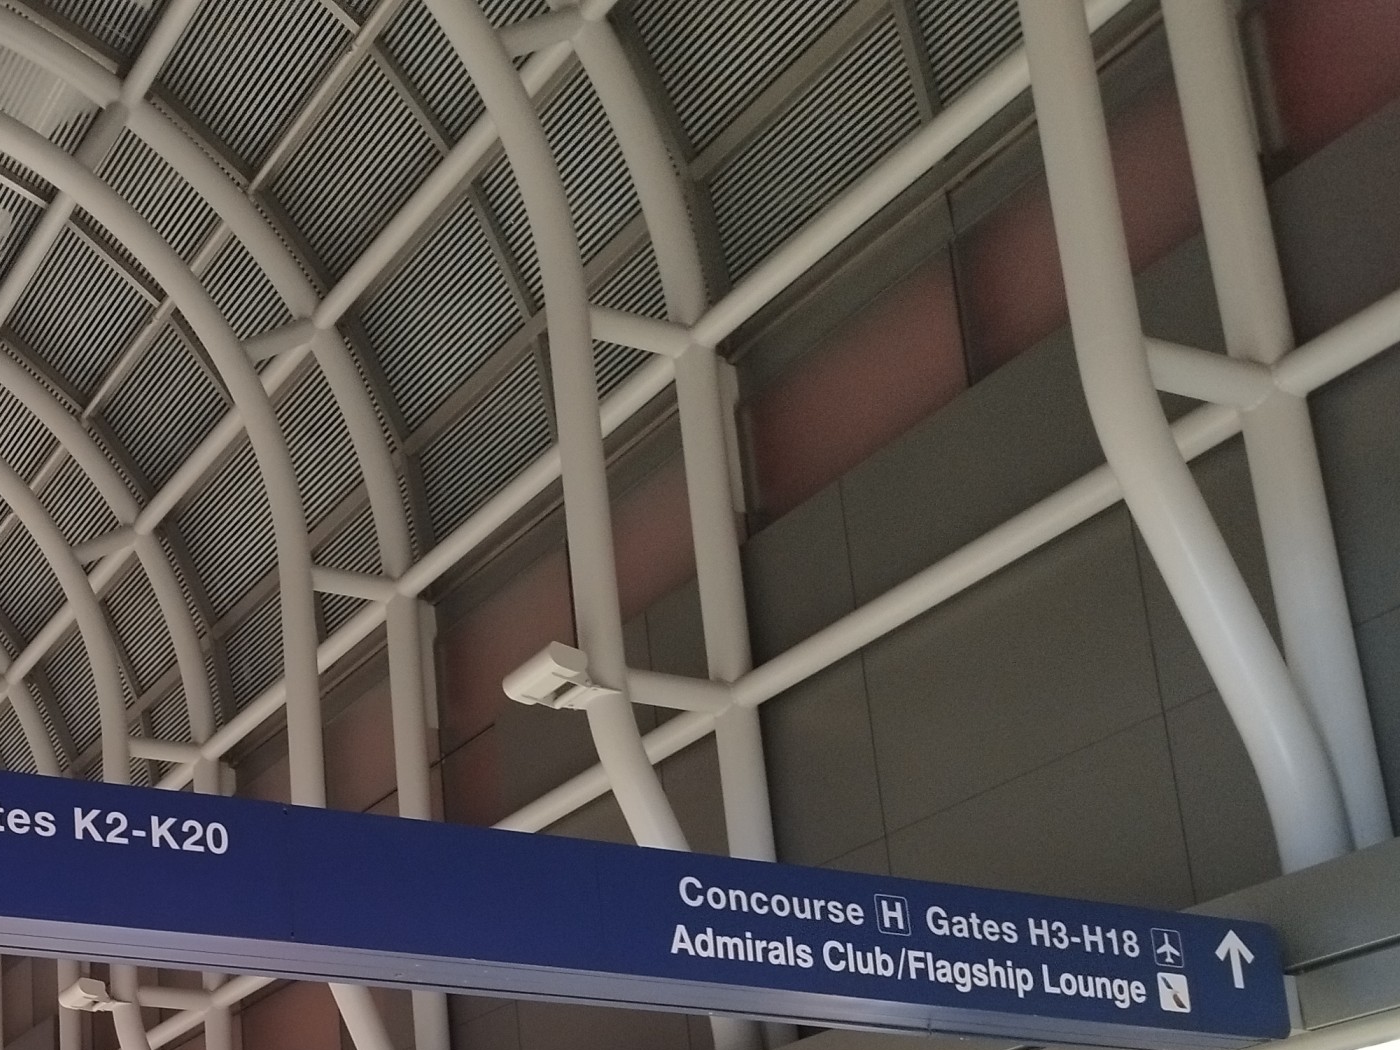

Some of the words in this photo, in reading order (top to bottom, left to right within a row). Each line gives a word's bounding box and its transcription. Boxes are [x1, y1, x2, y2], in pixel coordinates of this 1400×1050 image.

[73, 806, 229, 855] K2-K20
[678, 875, 866, 927] Concourse
[882, 901, 904, 931] H
[925, 906, 1019, 945] Gates
[1028, 918, 1141, 959] H3-H18
[670, 924, 814, 970] Admirals
[822, 939, 1034, 998] Club/Flagship
[1043, 971, 1147, 1010] Lounge
